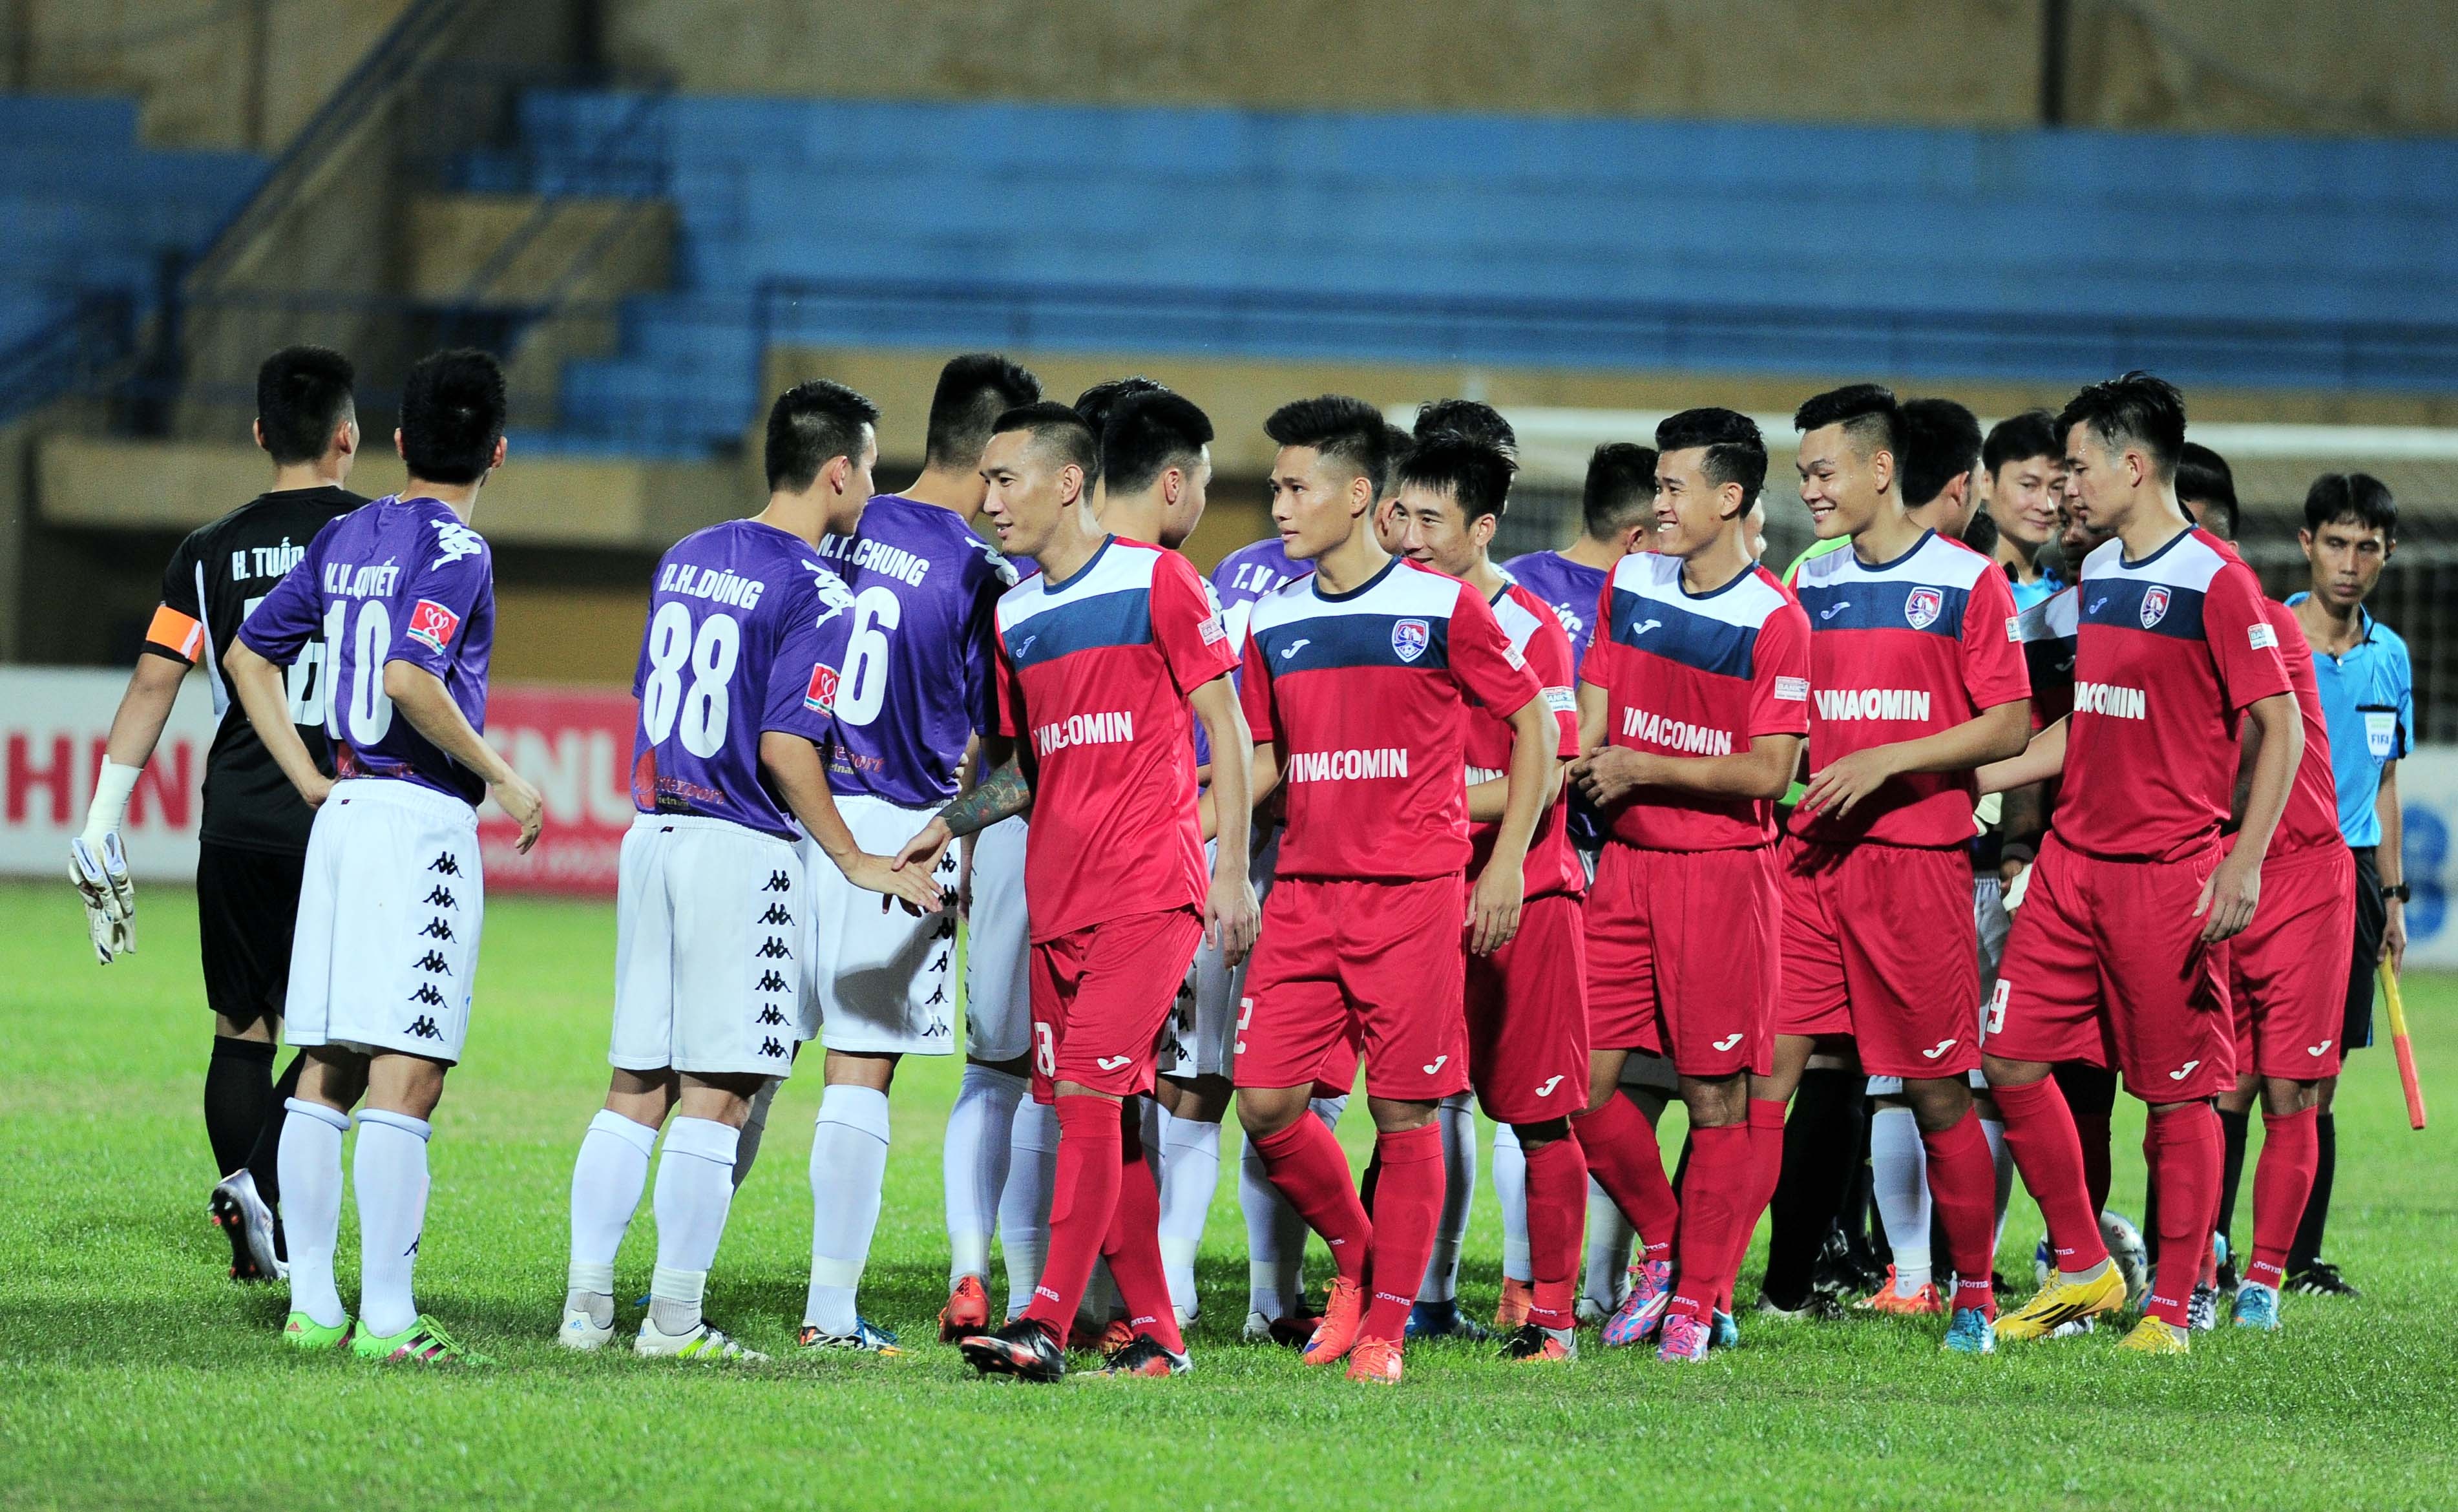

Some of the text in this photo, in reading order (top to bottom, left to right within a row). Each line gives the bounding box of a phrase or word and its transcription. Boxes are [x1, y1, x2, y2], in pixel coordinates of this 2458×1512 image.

[323, 600, 392, 745] 10
[643, 601, 740, 759] 88
[834, 585, 901, 726] 6
[1623, 706, 1732, 755] INACOMIN
[1987, 978, 2010, 1034] 9
